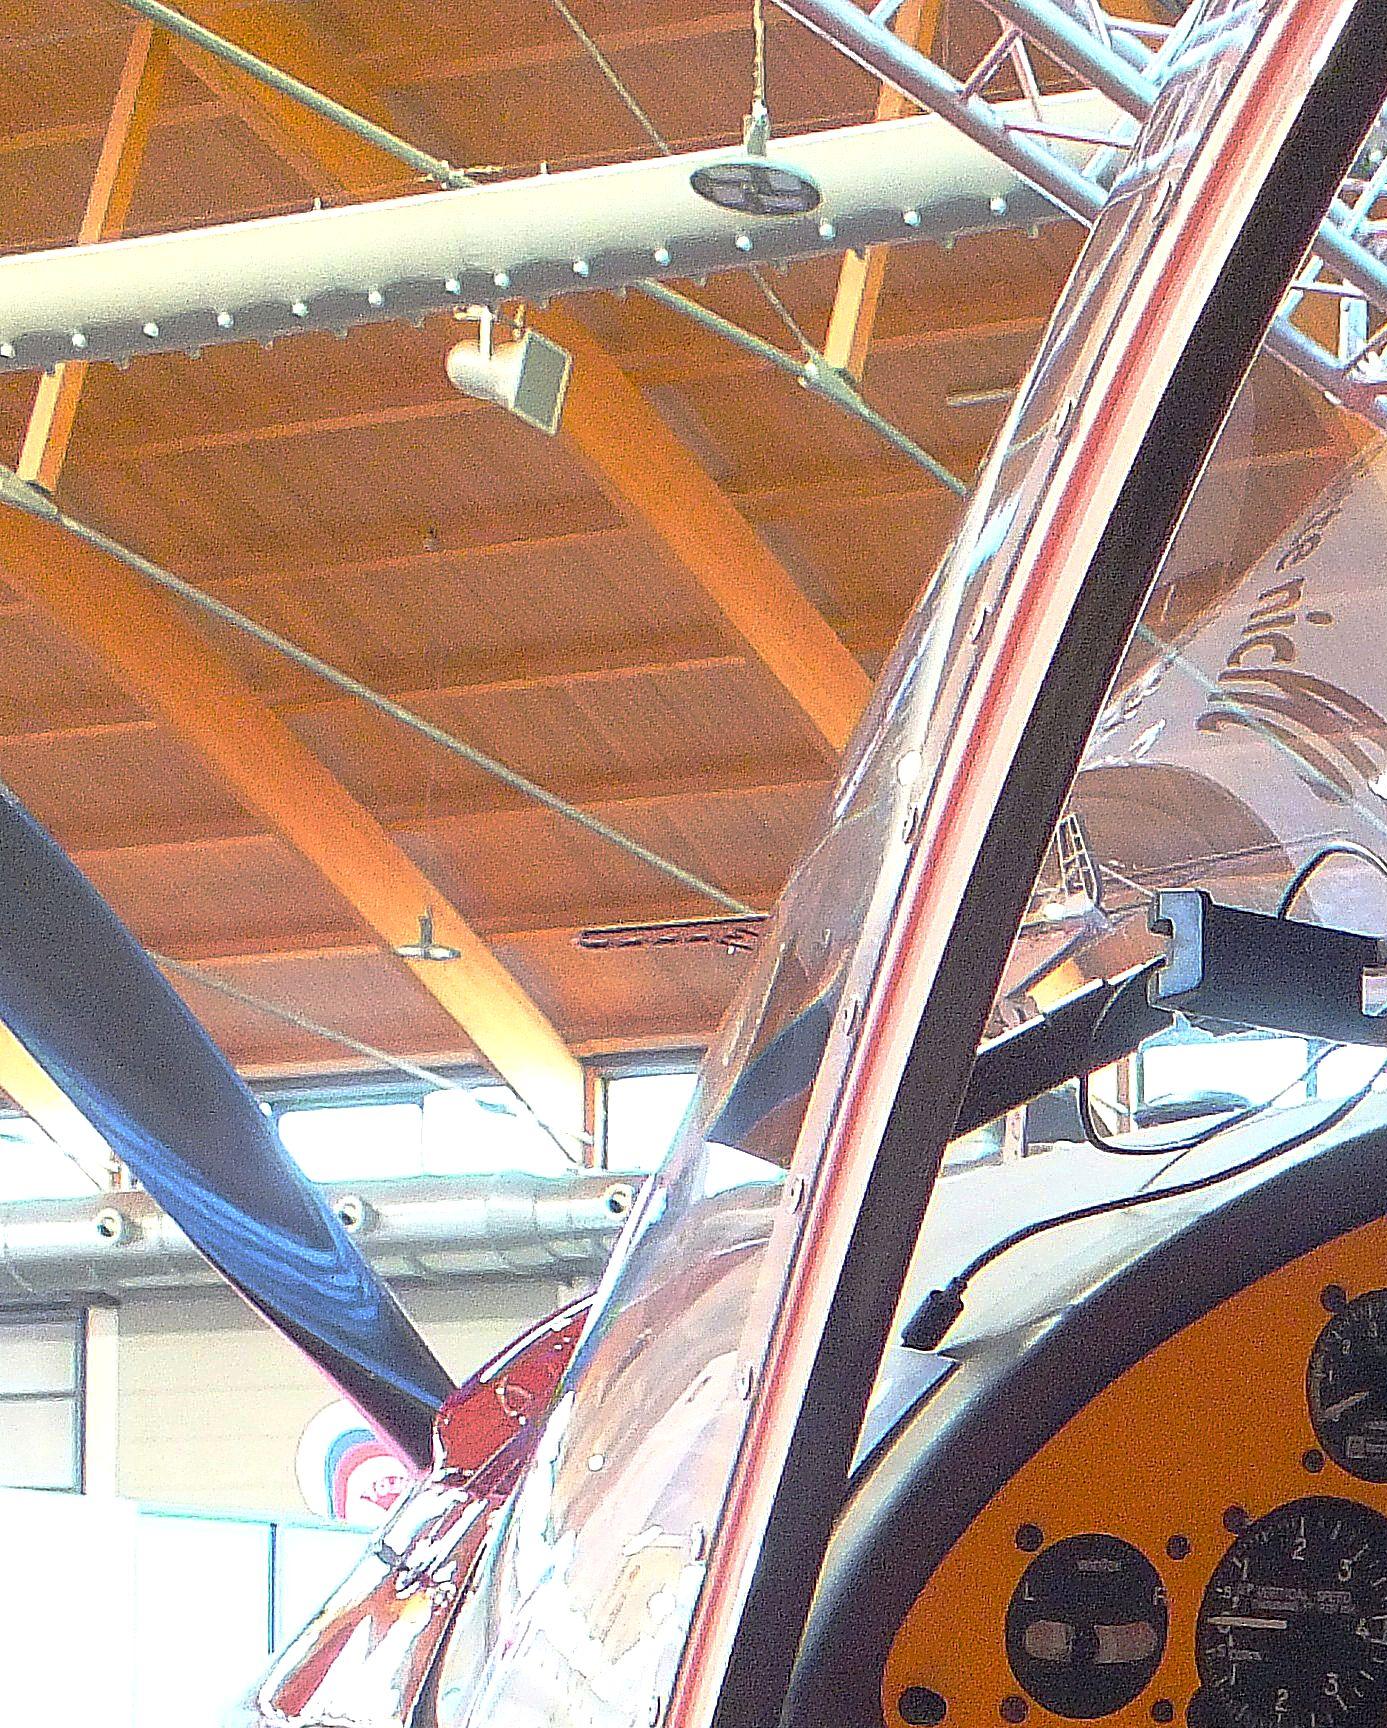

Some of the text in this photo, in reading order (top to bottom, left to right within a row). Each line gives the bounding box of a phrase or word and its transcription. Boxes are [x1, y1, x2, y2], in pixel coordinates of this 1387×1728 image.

[1291, 1538, 1306, 1561] 2
[1023, 1581, 1036, 1602] L
[1323, 1672, 1339, 1696] 3
[1274, 1688, 1289, 1712] 2
